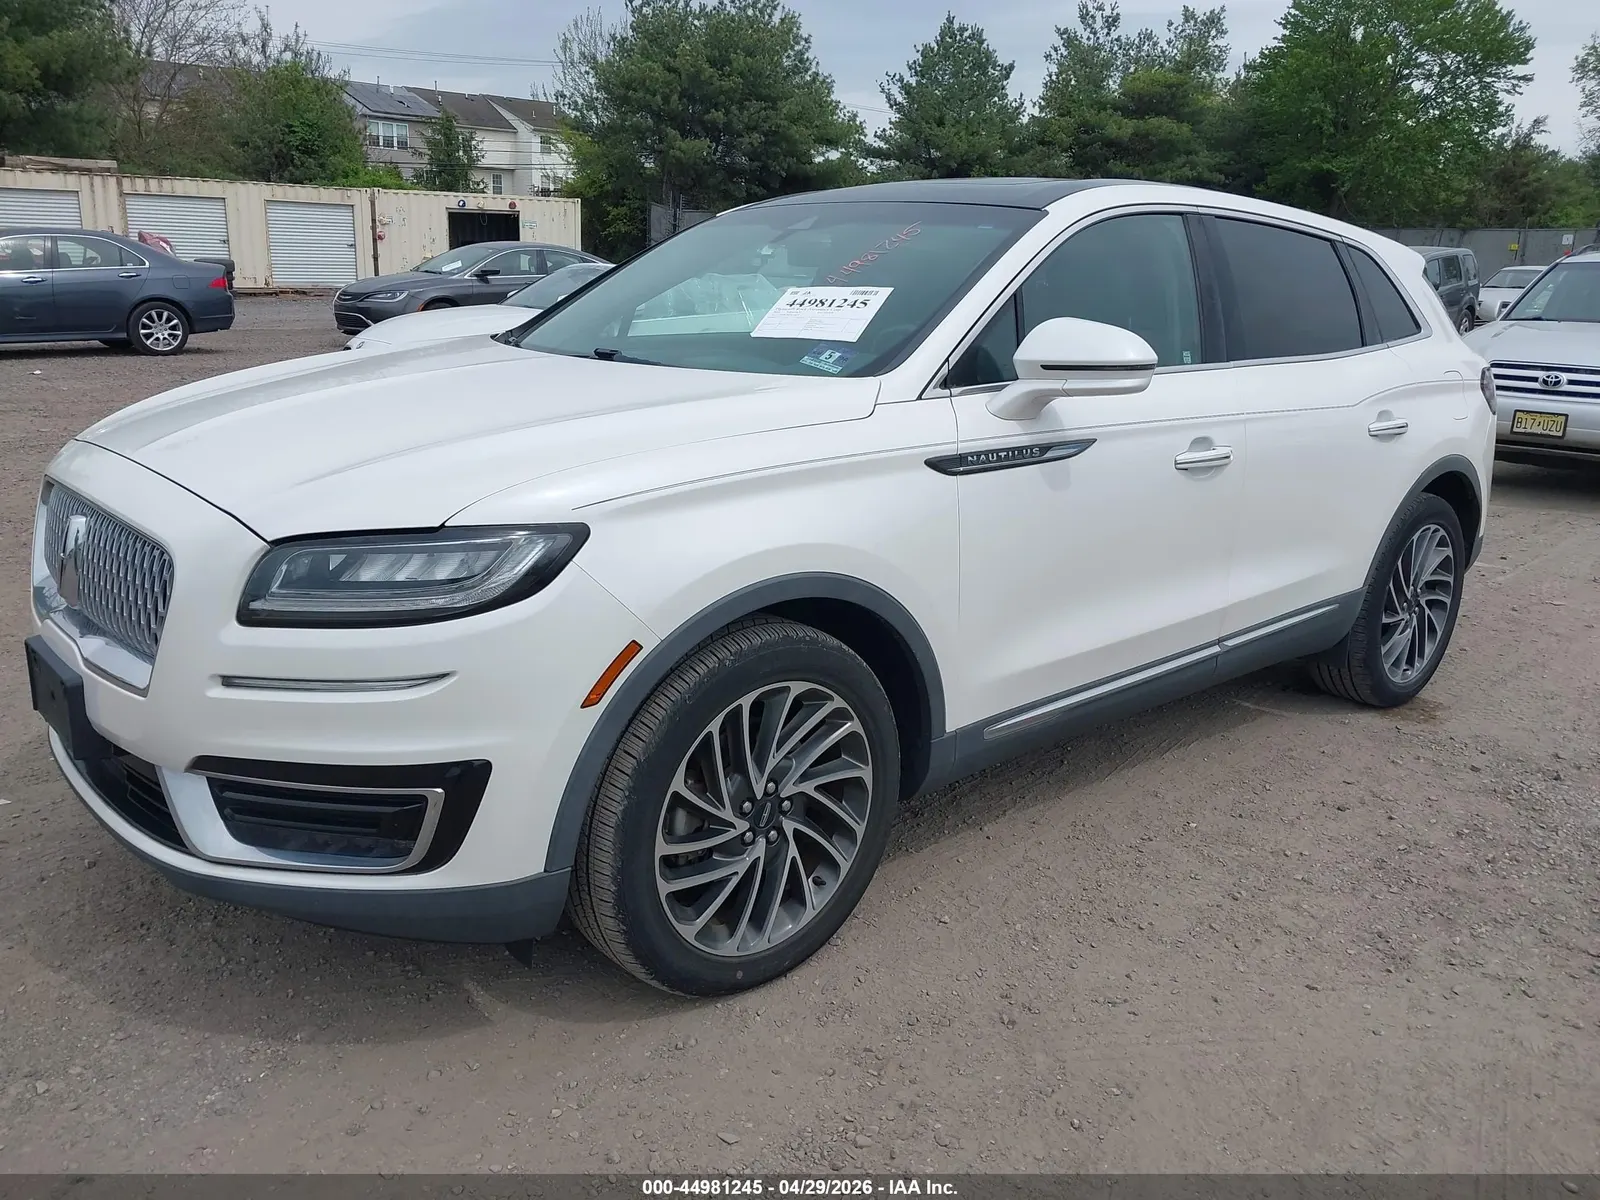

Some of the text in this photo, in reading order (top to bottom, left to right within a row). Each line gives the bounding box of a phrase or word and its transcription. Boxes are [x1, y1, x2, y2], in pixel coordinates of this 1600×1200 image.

[786, 298, 871, 309] 44981245
[824, 351, 836, 360] 5
[967, 447, 1040, 465] NAUTILUS
